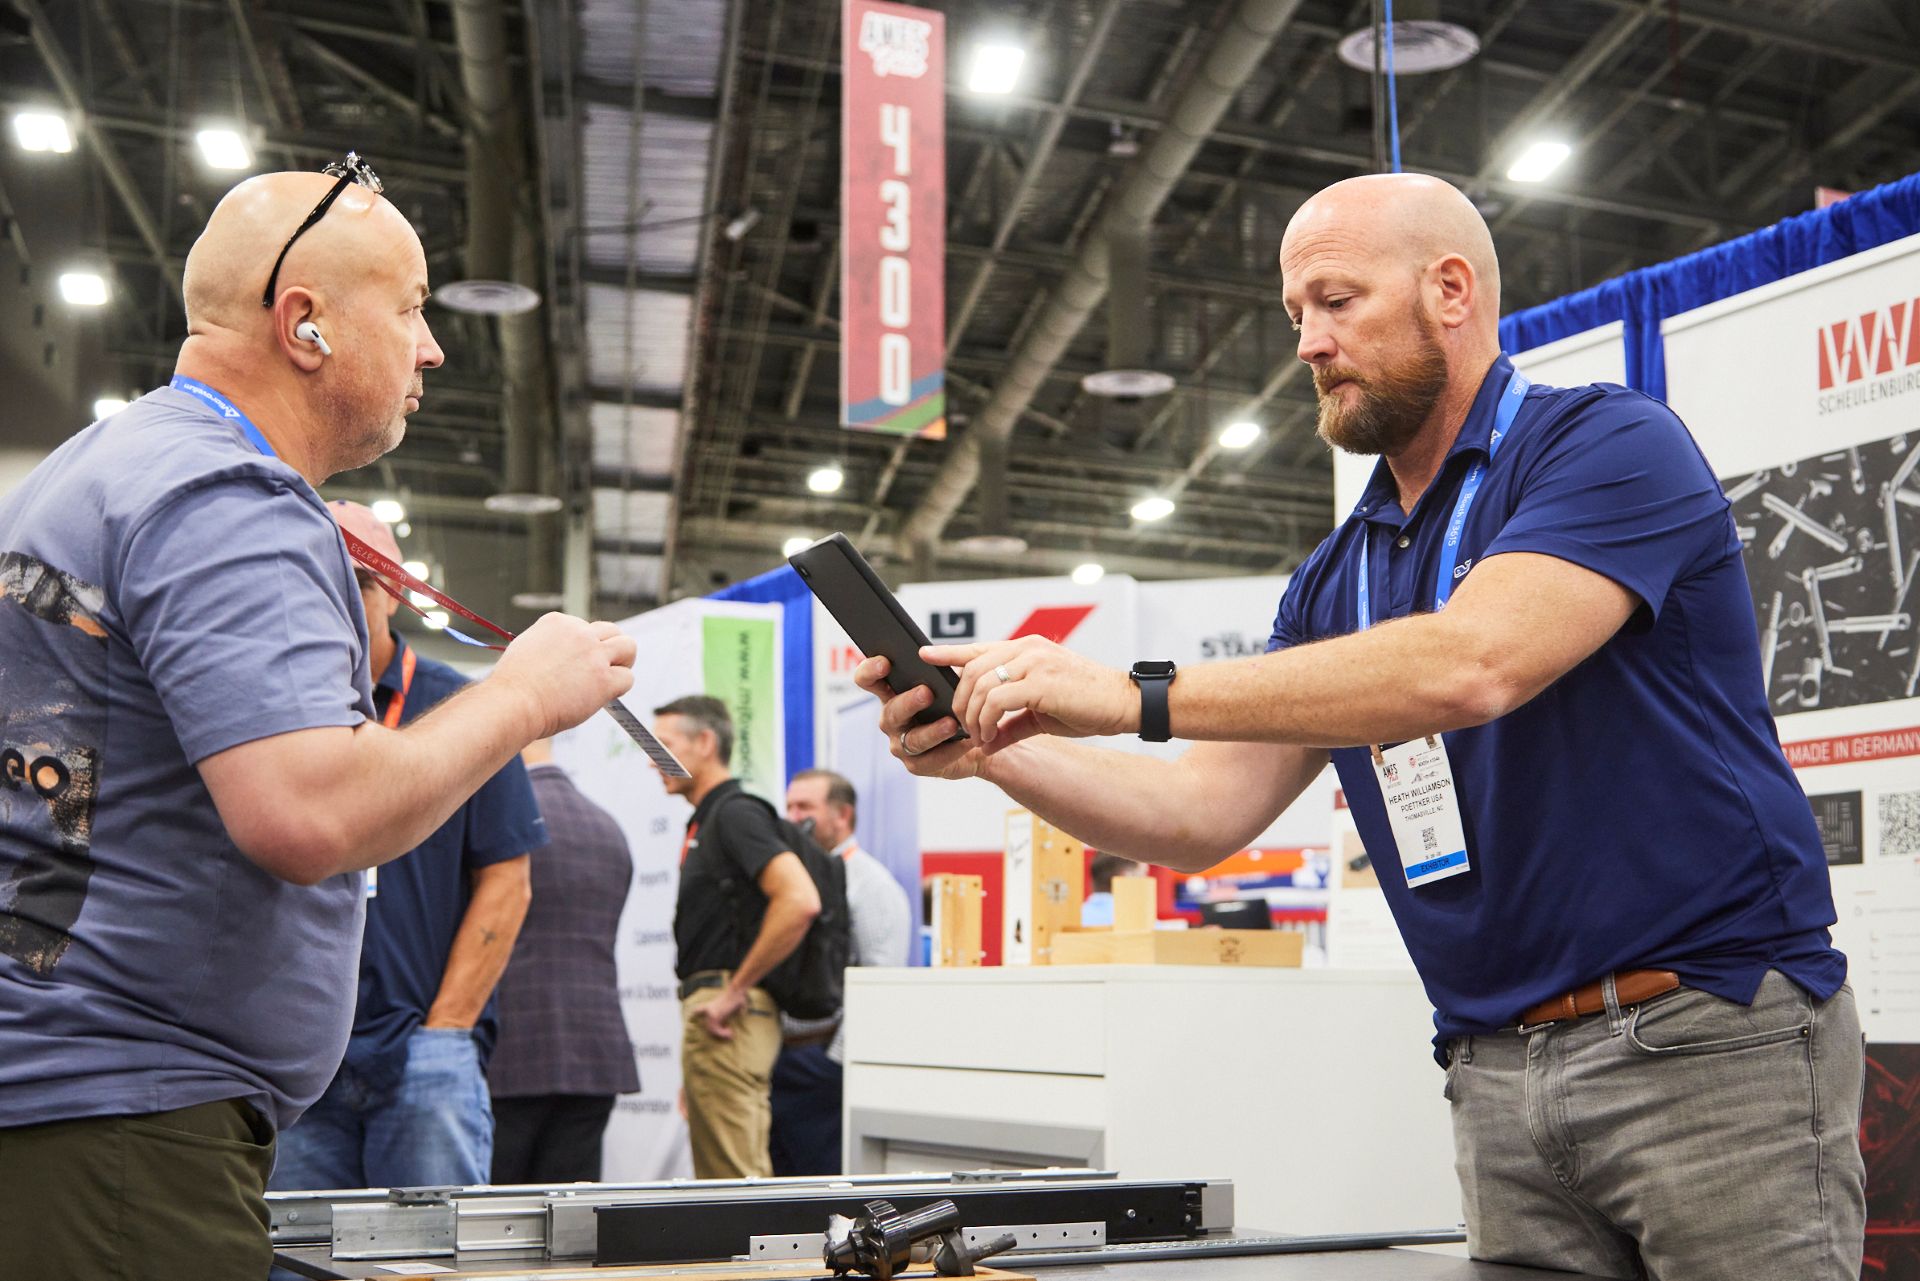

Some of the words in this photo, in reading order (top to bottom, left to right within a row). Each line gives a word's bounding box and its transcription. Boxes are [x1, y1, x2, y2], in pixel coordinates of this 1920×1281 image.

[879, 104, 912, 406] 4300
[1456, 492, 1473, 517] Booth
[350, 543, 378, 564] #3733
[380, 560, 407, 582] Booth
[1790, 742, 1830, 763] MADE
[1833, 740, 1848, 760] IN
[1852, 731, 1920, 757] GERMANY
[1389, 792, 1410, 805] HEATH
[1411, 778, 1451, 798] WILLIAMSON
[1401, 799, 1430, 813] POETTKER
[1432, 794, 1443, 804] USA
[1421, 857, 1450, 873] EXHIBITOR
